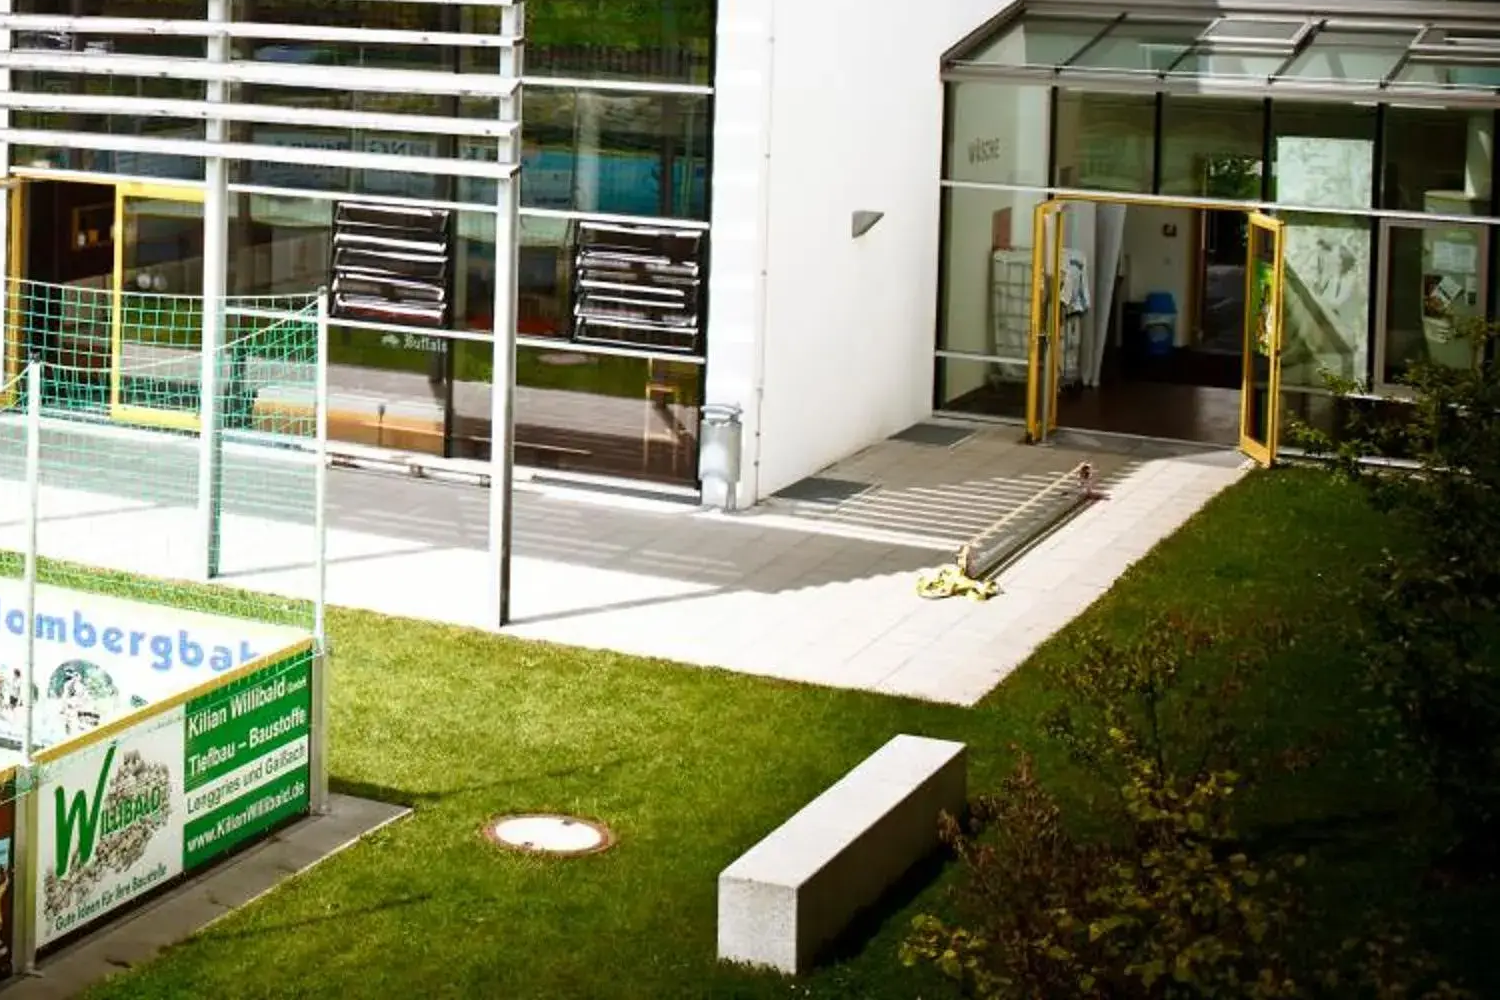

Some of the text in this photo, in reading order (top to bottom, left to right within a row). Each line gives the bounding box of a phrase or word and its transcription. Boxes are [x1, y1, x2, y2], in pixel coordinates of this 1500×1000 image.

[187, 707, 228, 740] Kilian
[229, 676, 286, 720] Willibald
[188, 741, 236, 776] Tiefbau
[249, 706, 307, 748] Baustoffe
[187, 777, 241, 814] Lenggries
[243, 763, 263, 787] und
